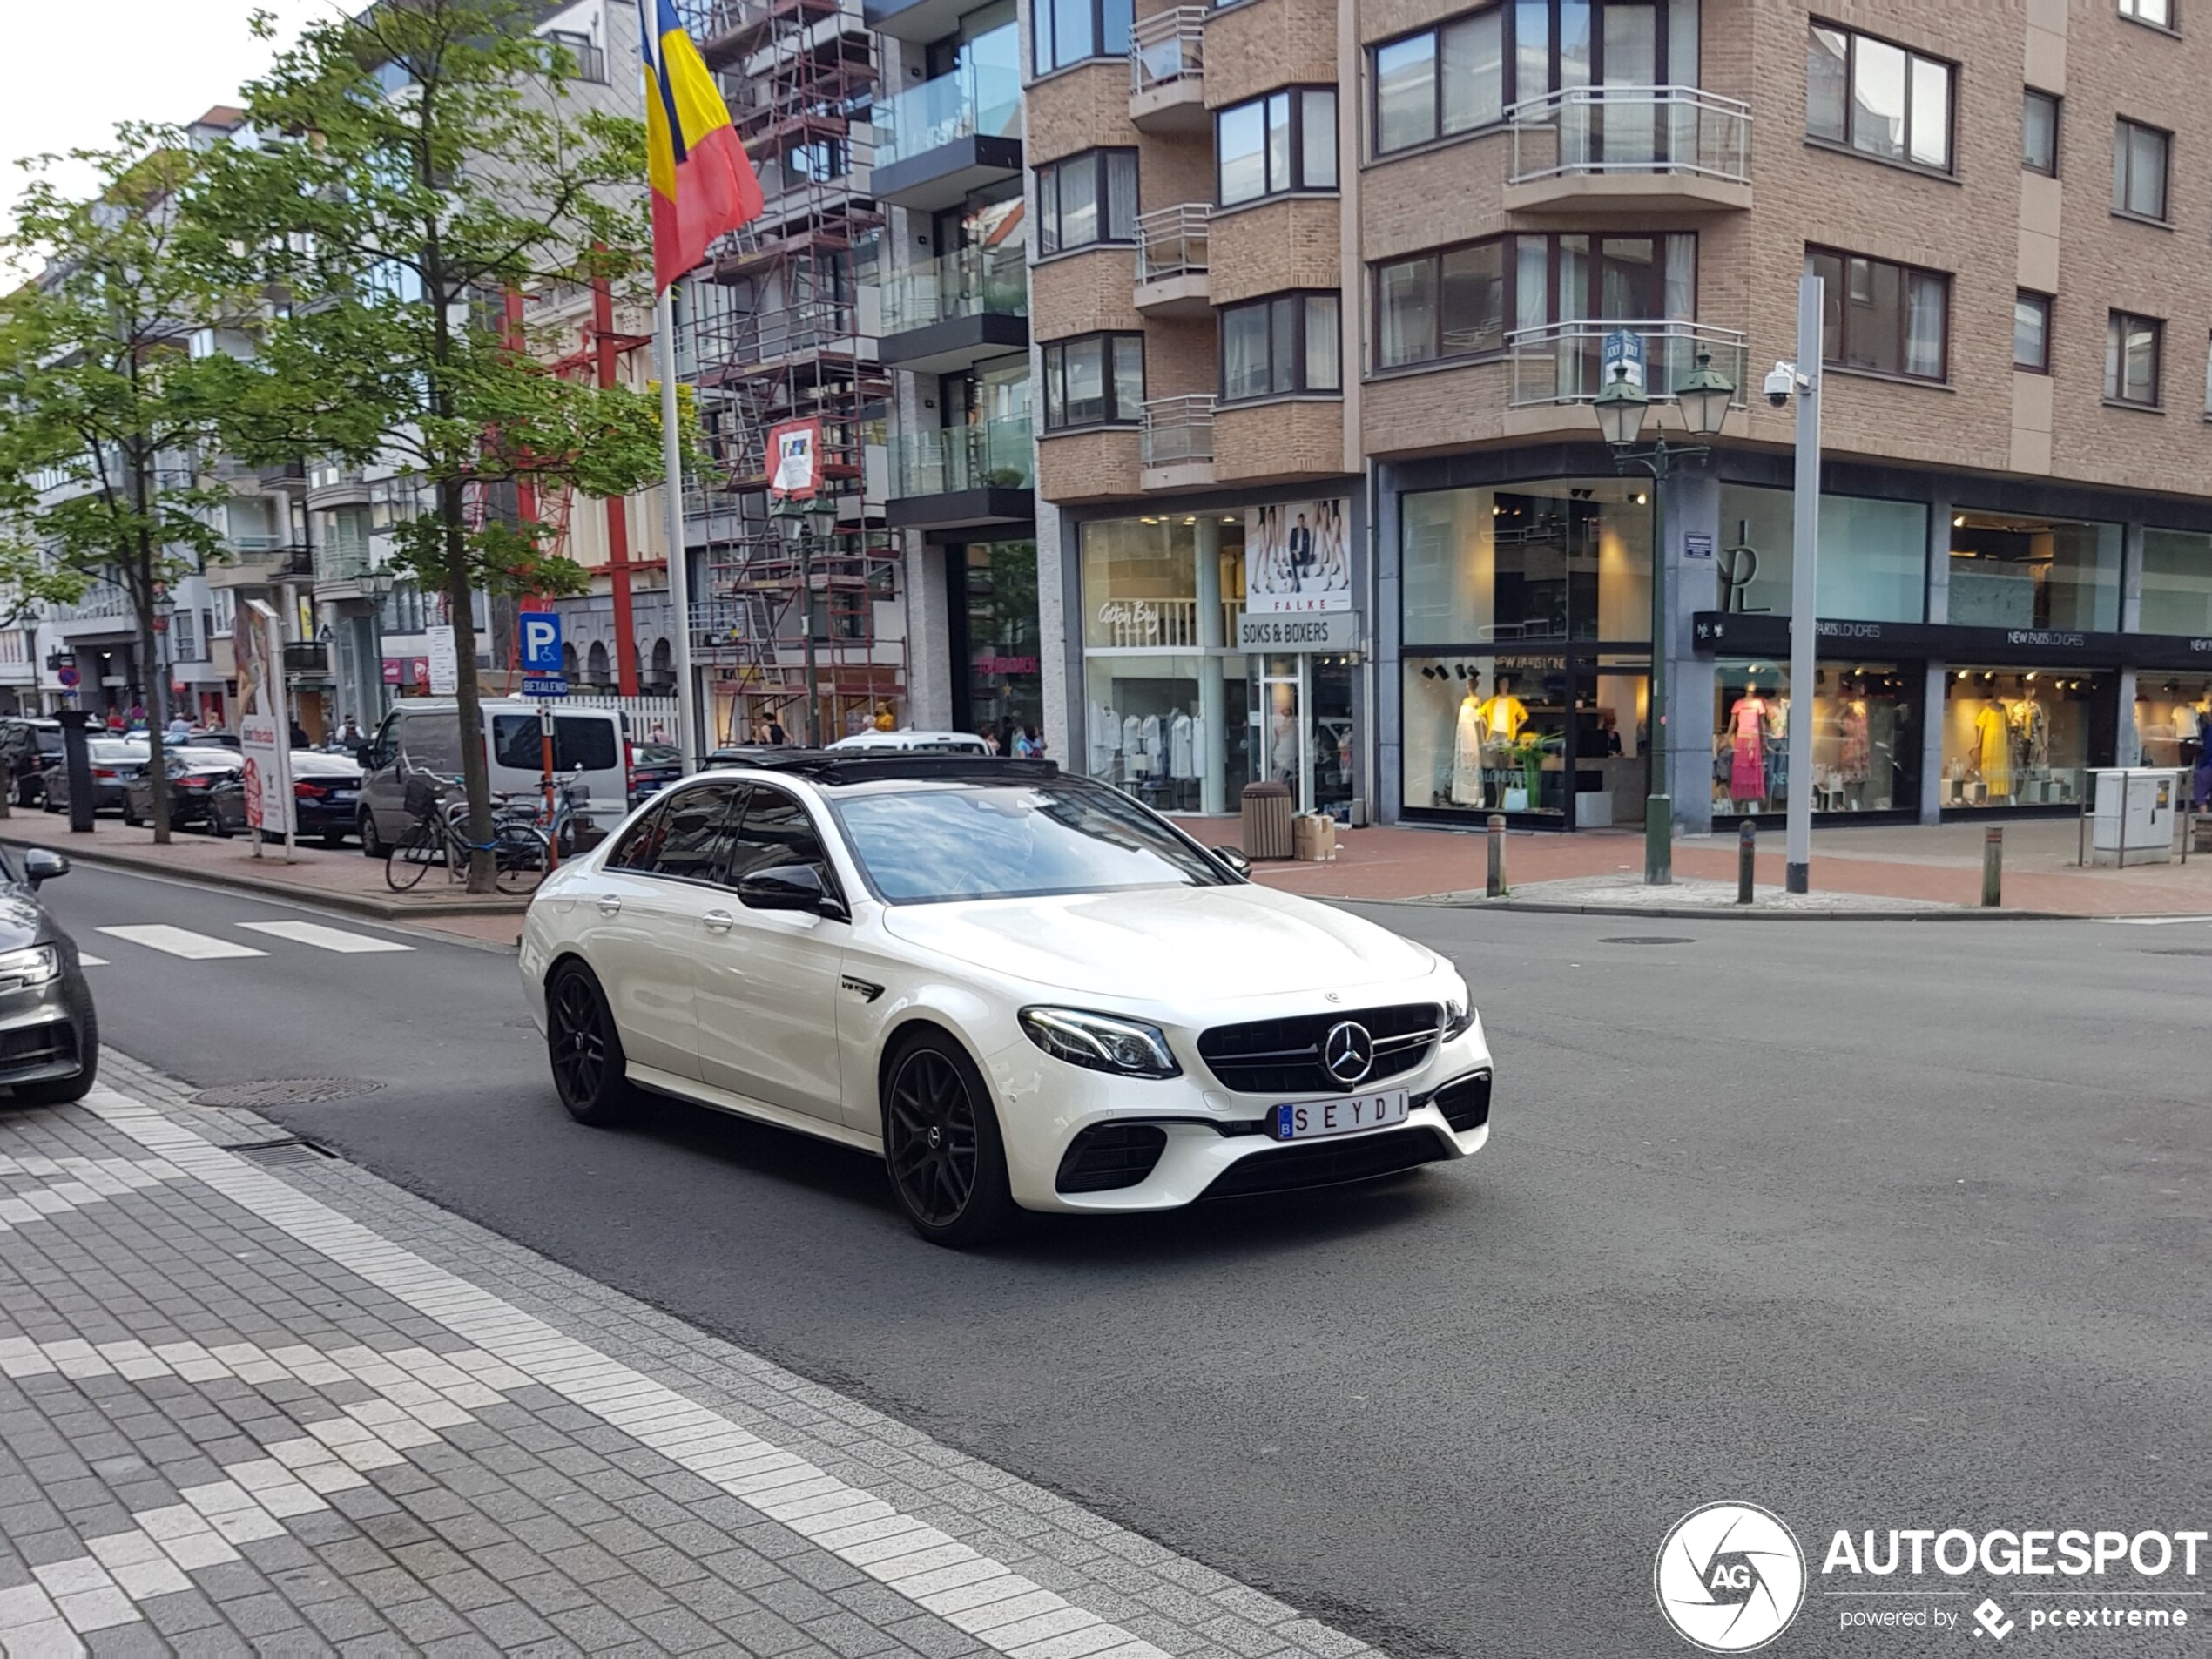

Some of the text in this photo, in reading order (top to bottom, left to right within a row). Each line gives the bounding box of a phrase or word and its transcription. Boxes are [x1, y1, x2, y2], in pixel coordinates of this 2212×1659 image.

[1274, 599, 1326, 610] FALKE
[1098, 600, 1157, 635] Cotton Bay
[526, 621, 556, 662] P
[1243, 621, 1329, 643] SOKS & BOXERS
[2007, 631, 2028, 644] NEW
[2028, 631, 2049, 645] PARIS
[523, 679, 568, 694] BETALEND
[1281, 1093, 1404, 1135] B SEYDI
